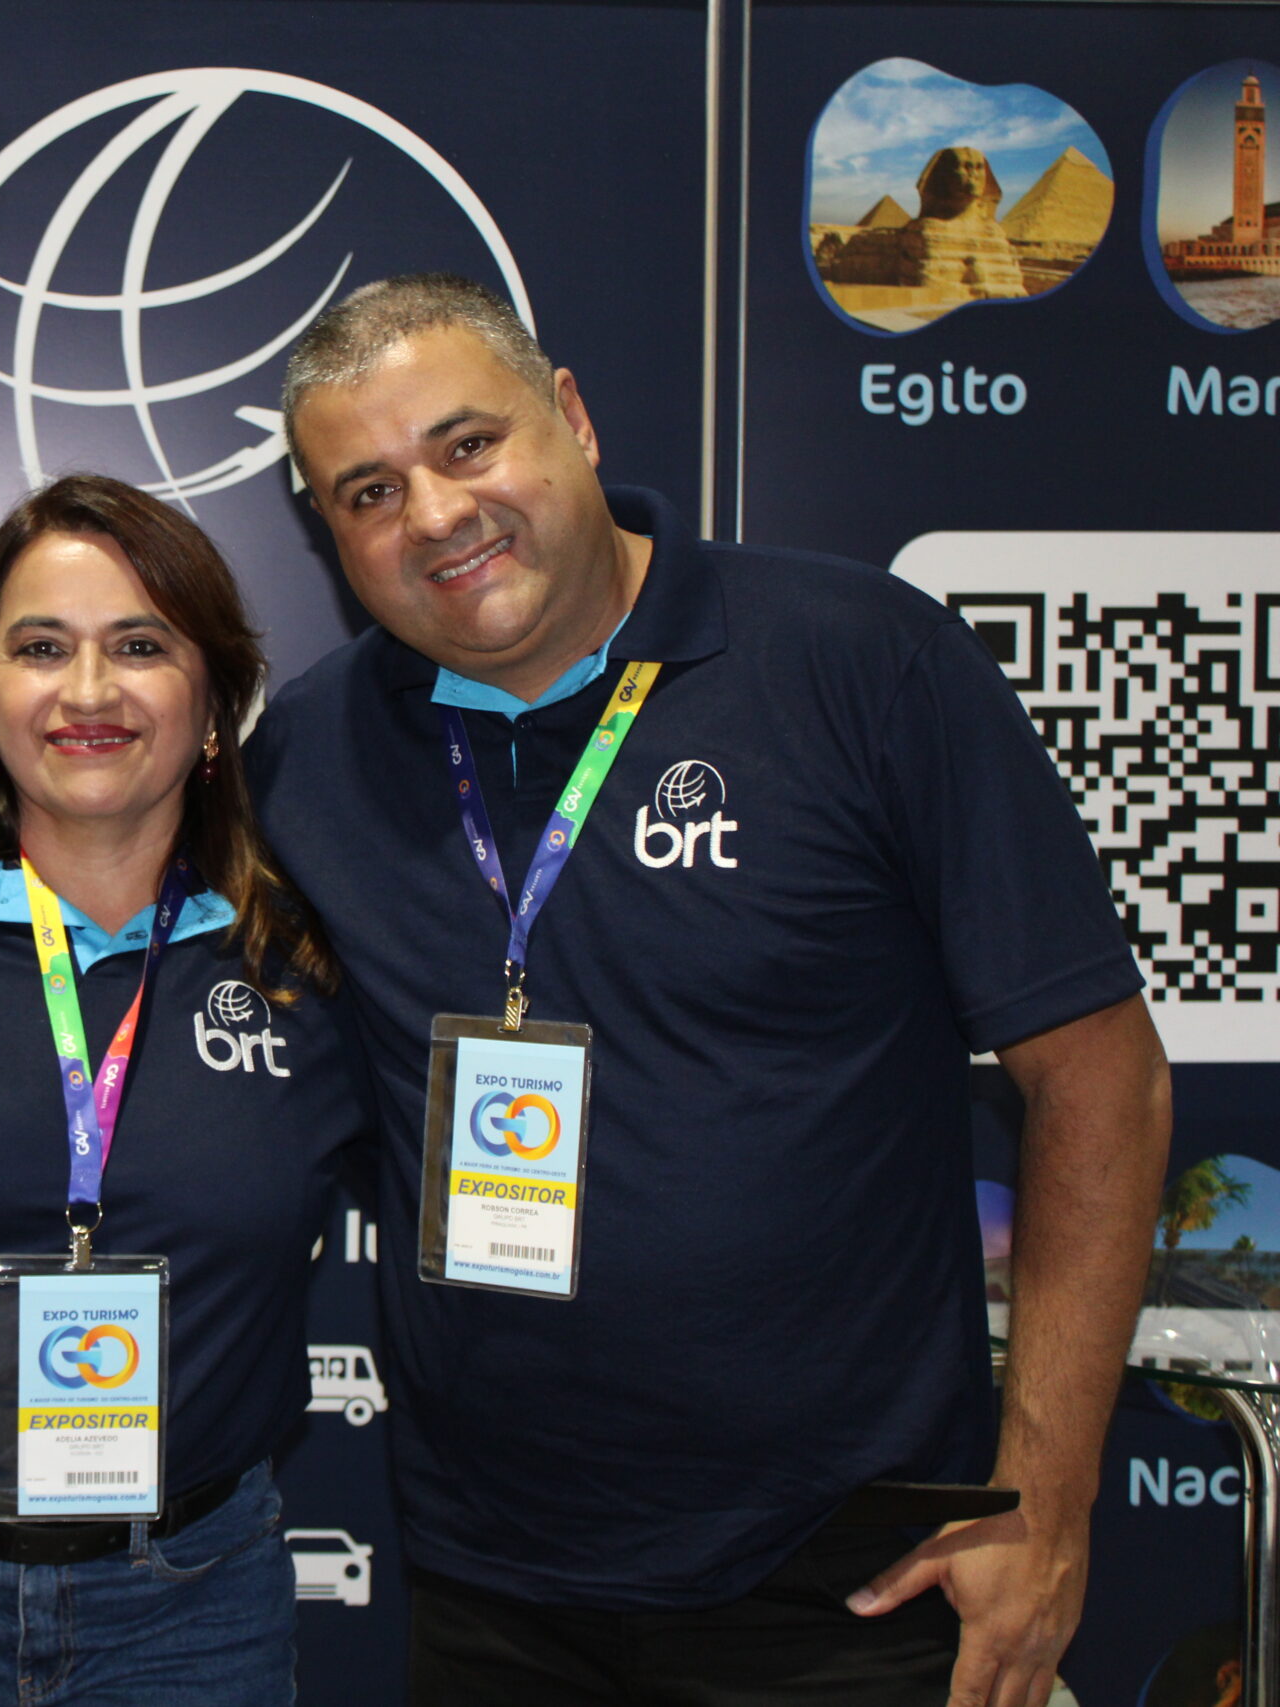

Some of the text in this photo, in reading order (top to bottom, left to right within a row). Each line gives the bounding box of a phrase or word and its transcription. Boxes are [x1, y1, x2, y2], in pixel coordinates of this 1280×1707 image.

[860, 361, 1027, 426] Egito
[634, 805, 738, 869] brt
[194, 1011, 291, 1077] brt
[475, 1074, 563, 1092] EXPO TURISMO
[458, 1178, 566, 1205] EXPOSITOR
[481, 1204, 538, 1216] ROBSON CORREA
[42, 1308, 139, 1321] EXPO TURISMO
[29, 1413, 149, 1430] EXPOSITOR
[1129, 1457, 1240, 1507] Nac
